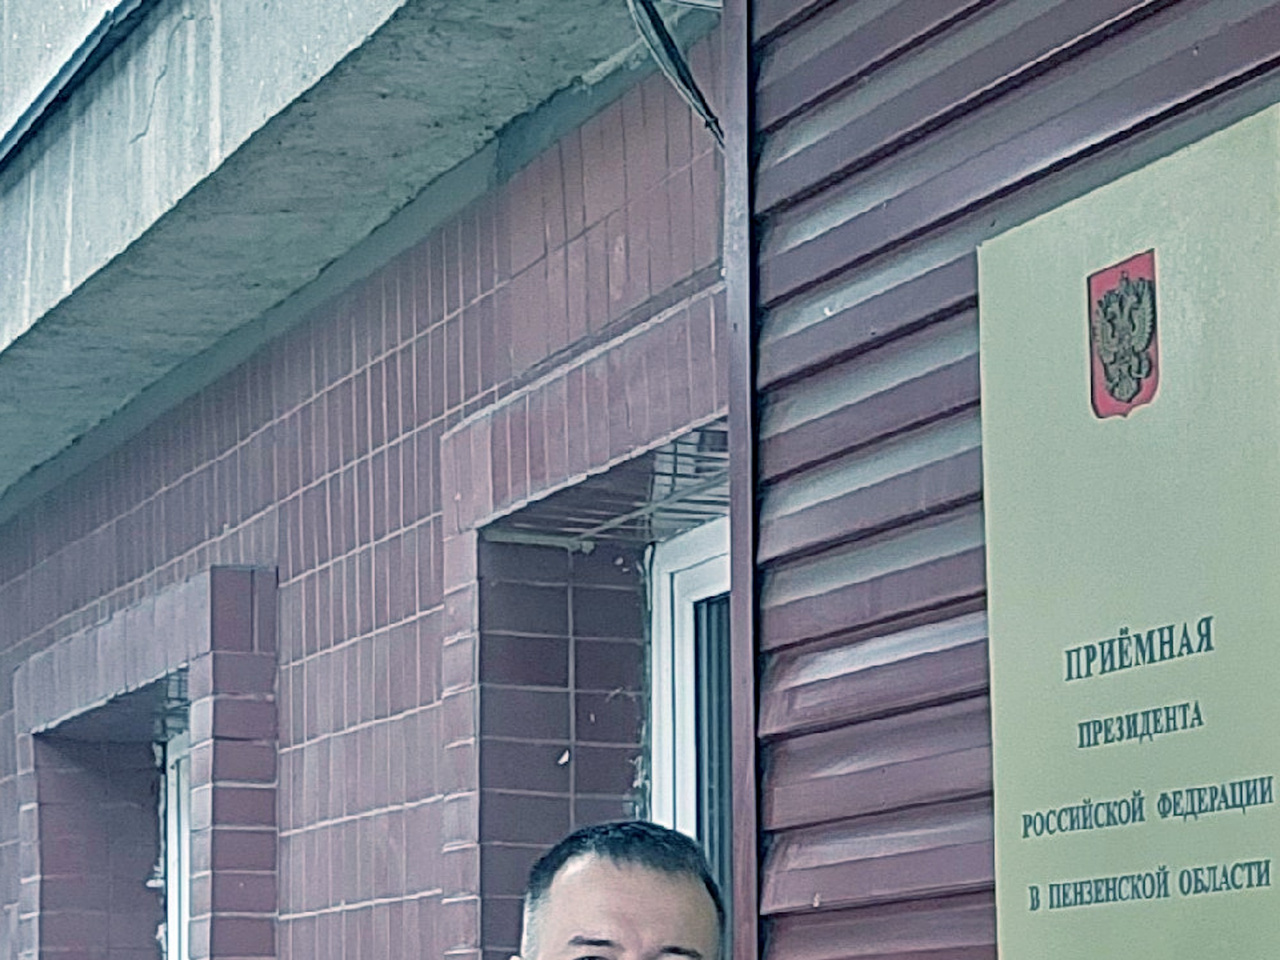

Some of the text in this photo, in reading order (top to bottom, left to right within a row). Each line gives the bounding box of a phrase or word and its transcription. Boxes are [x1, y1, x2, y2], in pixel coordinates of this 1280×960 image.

[1064, 615, 1215, 682] ПРИЁМНАЯ
[1077, 700, 1205, 749] ПРЕЗИДЕНТА
[1021, 776, 1274, 838] РОССИЙСКОЙ ФЕДЕРАЦИИ
[1029, 859, 1272, 912] В ПЕНЗЕНСКОЙ ОБЛАСТИ
